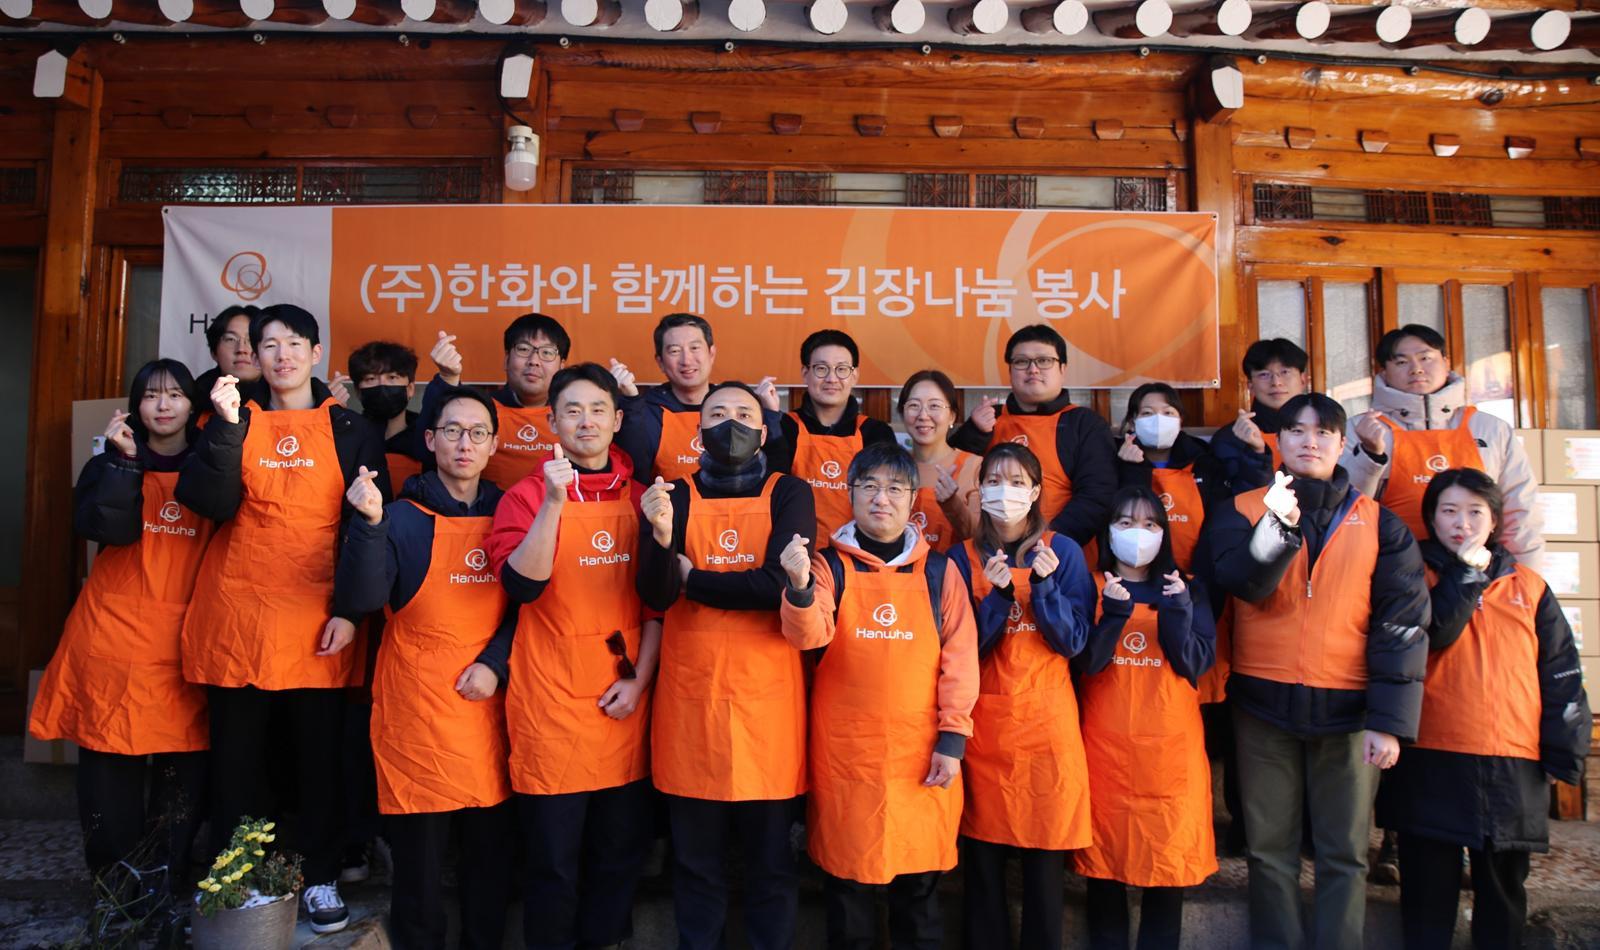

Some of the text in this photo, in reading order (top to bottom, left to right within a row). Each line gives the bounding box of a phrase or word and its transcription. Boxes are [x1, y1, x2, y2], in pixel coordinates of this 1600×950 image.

[359, 262, 1127, 319] (주)한화와 함께하는 김장나눔 봉사
[503, 441, 553, 451] Hanwha
[259, 457, 314, 469] Hanwha
[143, 520, 197, 537] Hanwha
[579, 552, 631, 567] Hanwha
[705, 552, 755, 565] Hanwha
[449, 572, 498, 584] Hanwh
[855, 627, 914, 641] Hanwha
